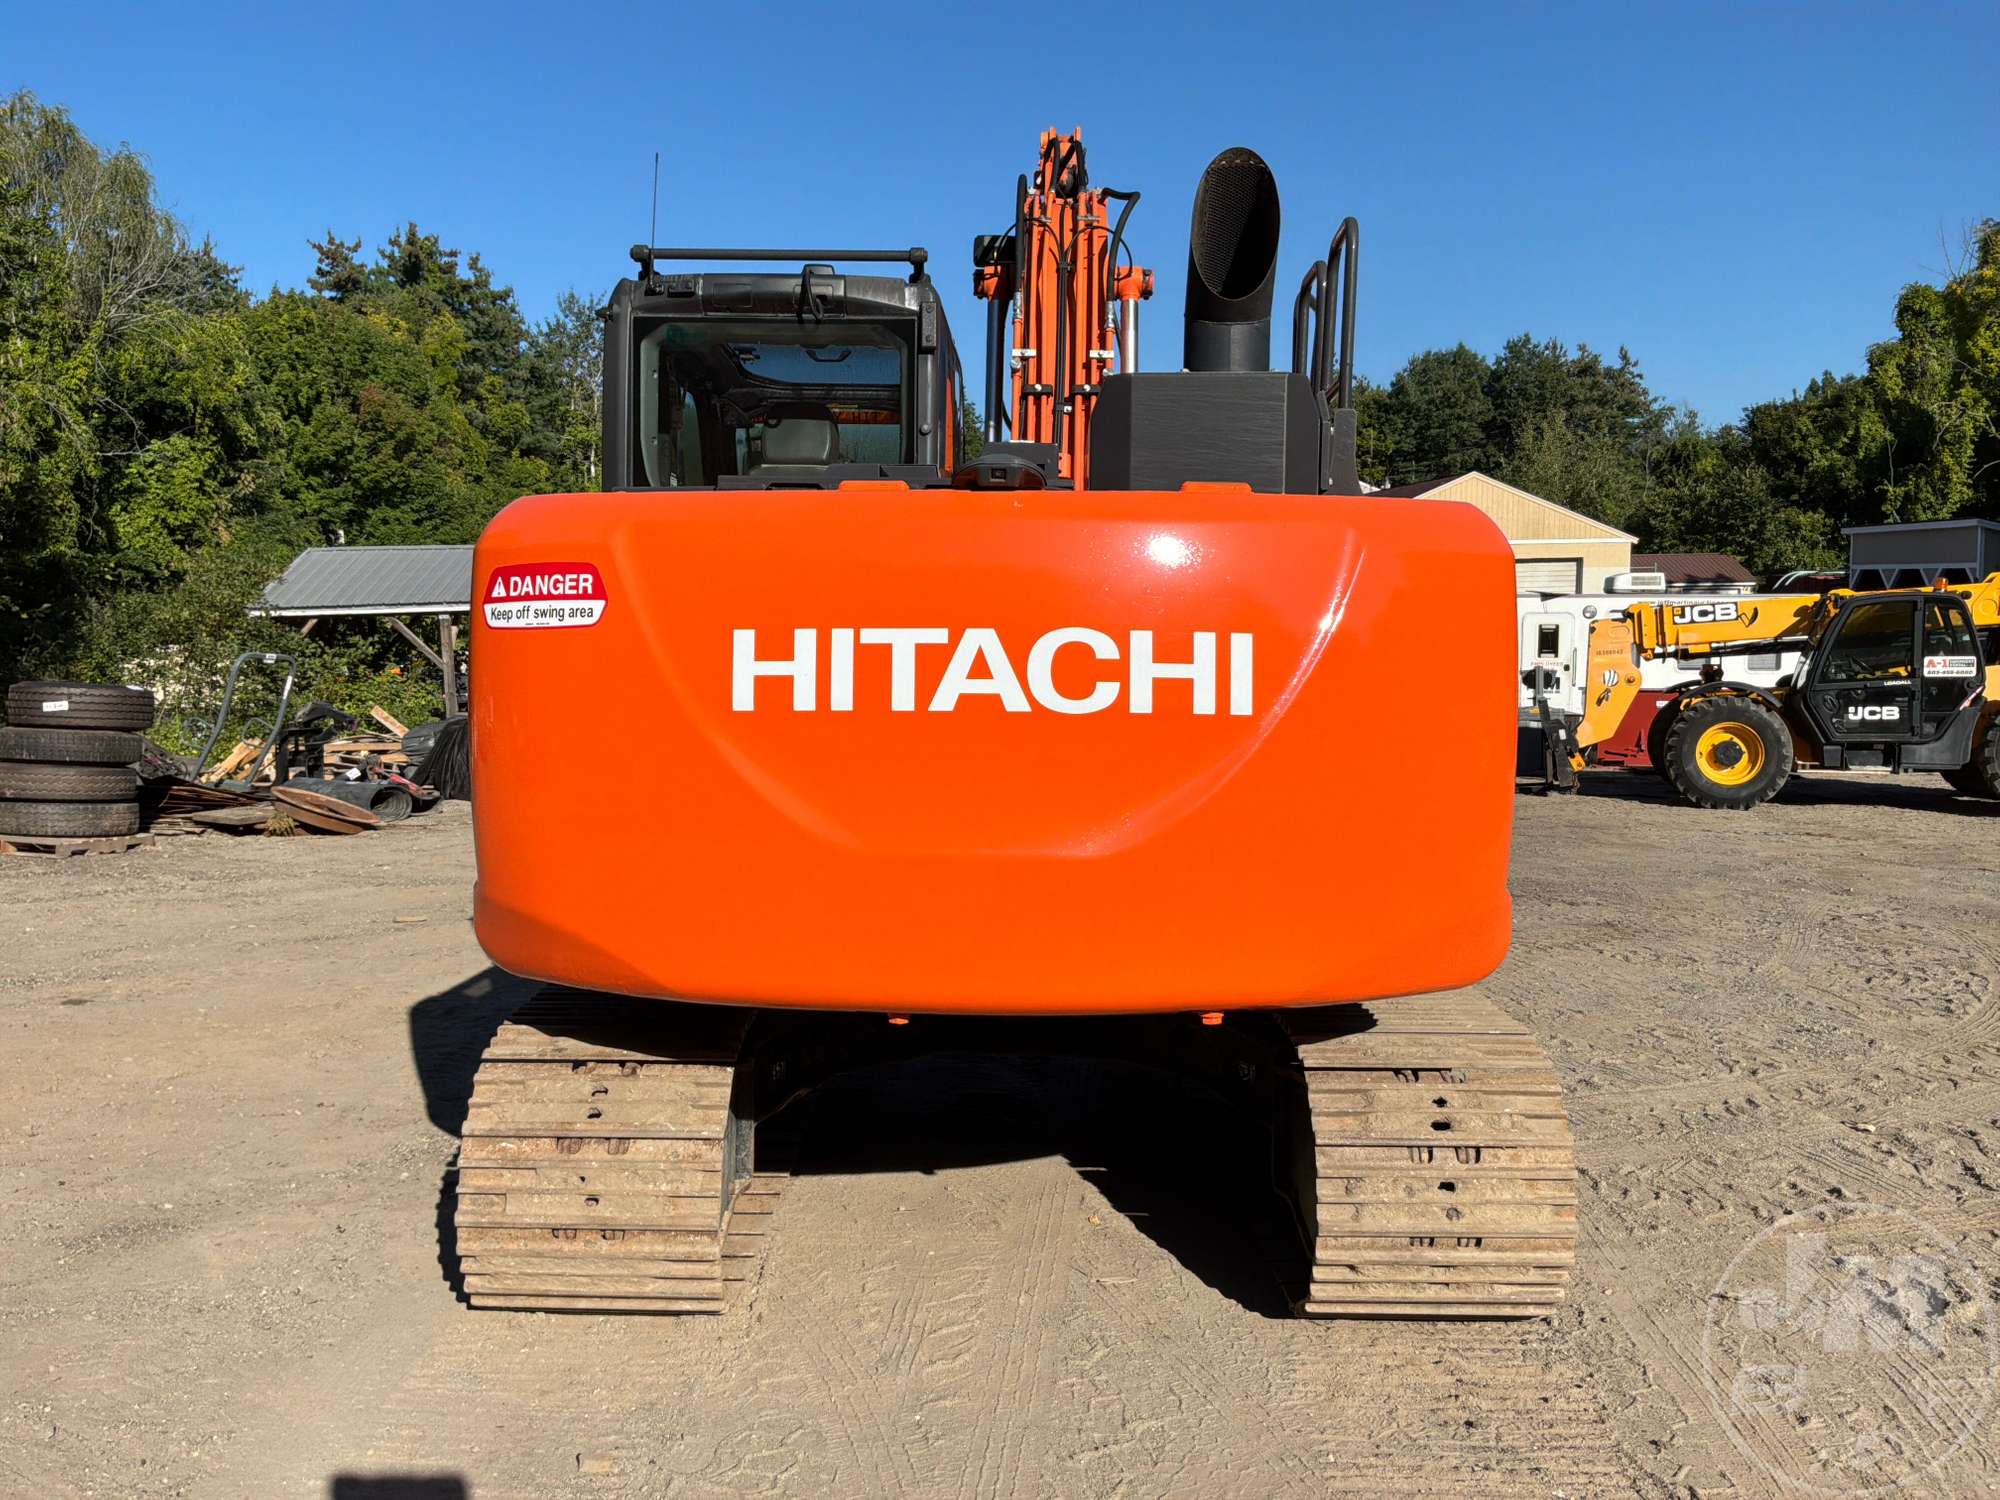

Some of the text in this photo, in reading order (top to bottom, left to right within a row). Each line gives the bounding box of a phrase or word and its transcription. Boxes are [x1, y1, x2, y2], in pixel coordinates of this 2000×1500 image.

[509, 573, 593, 597] DANGER
[490, 605, 594, 623] Keep off swing area
[1673, 603, 1738, 624] JCB
[732, 626, 1254, 716] HITACHI
[1926, 659, 1948, 668] A-1
[1848, 706, 1900, 720] JCB
